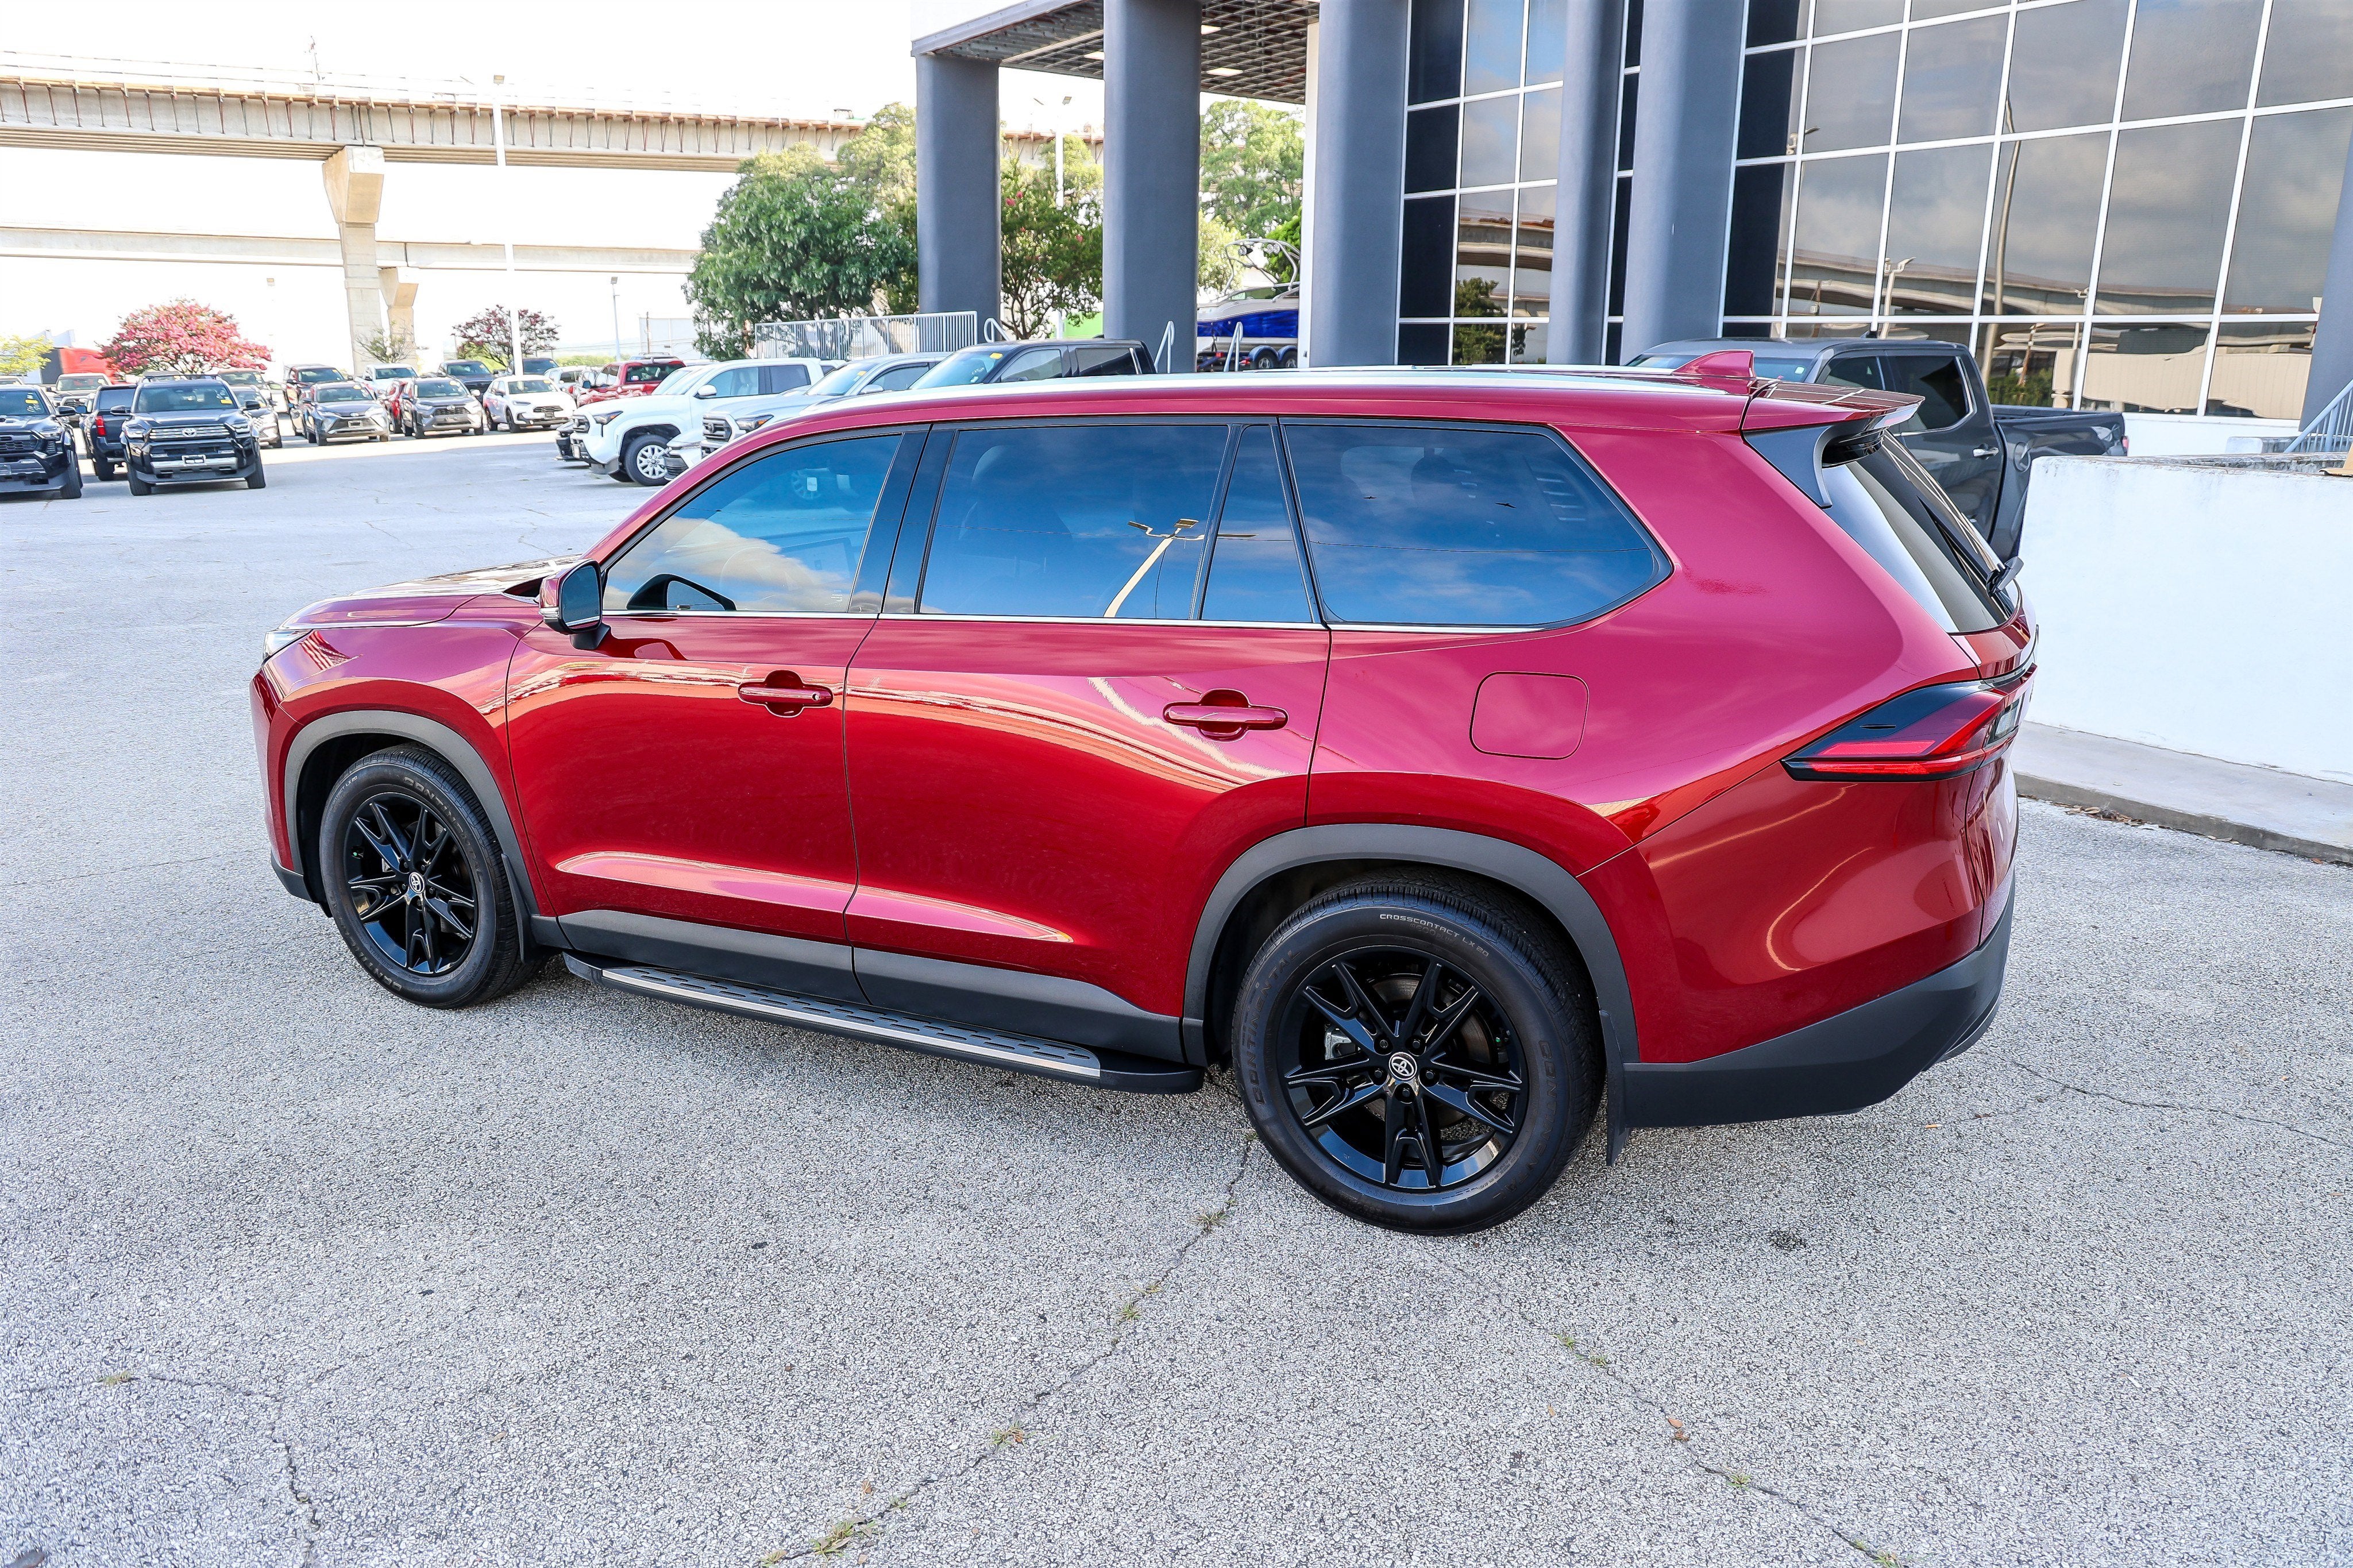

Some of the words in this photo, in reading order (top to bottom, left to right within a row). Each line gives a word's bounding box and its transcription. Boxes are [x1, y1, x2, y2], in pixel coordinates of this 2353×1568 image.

[1379, 914, 1460, 937] CROSSCONTACT
[1462, 937, 1475, 947] LX
[1476, 945, 1490, 957] 20
[1246, 949, 1301, 1105] CONTINENTAL
[1492, 1040, 1557, 1200] CONTINENTAL
